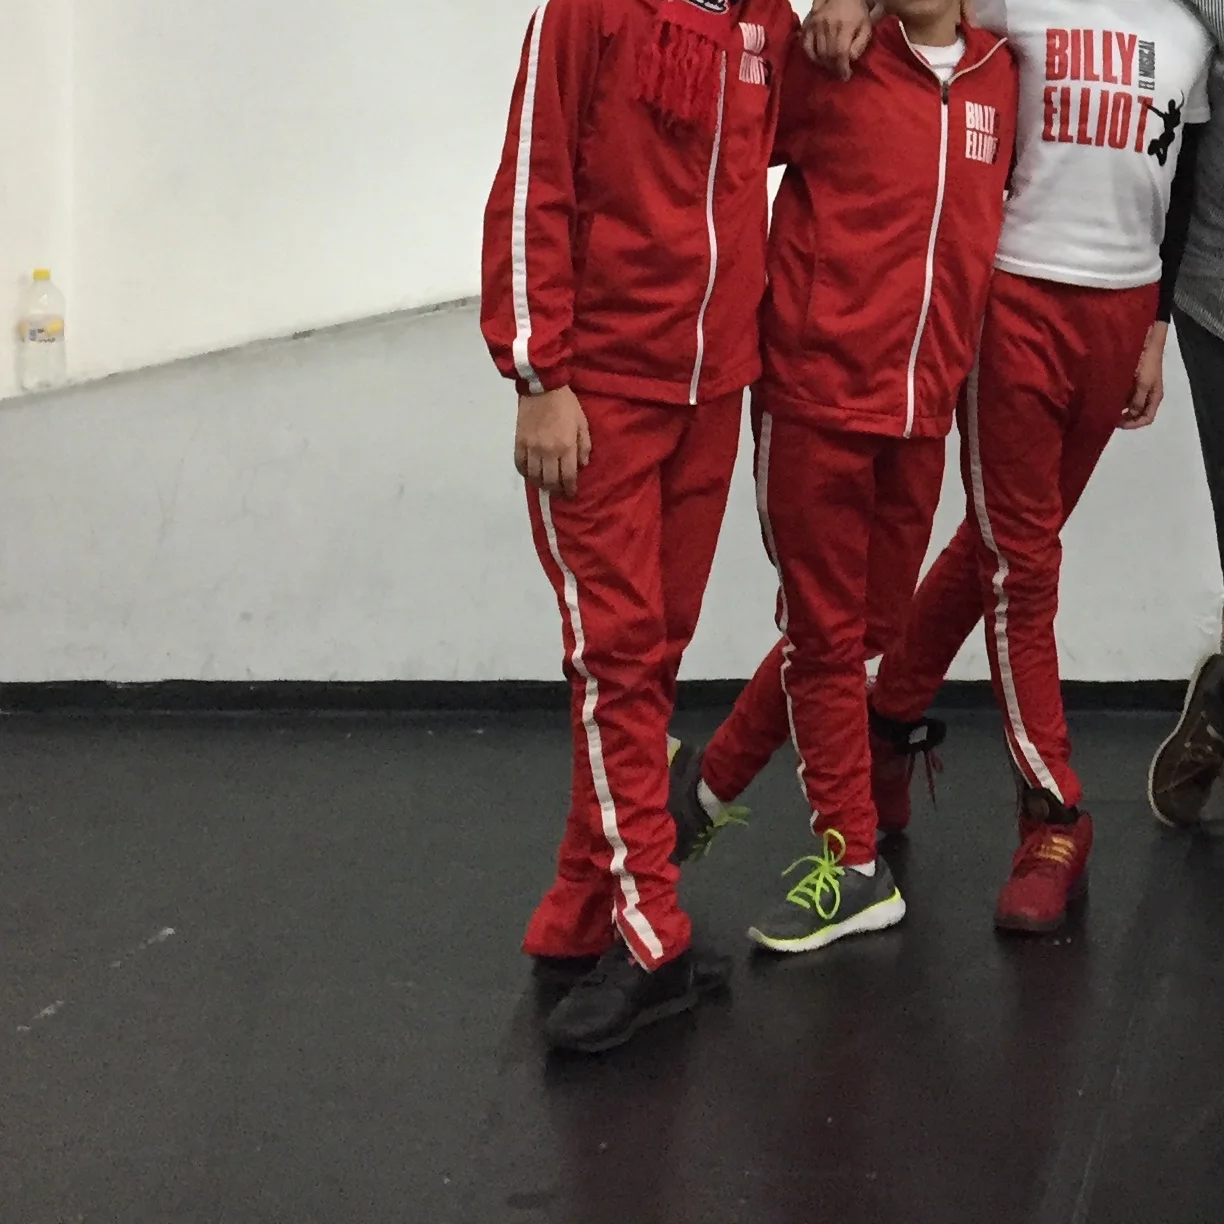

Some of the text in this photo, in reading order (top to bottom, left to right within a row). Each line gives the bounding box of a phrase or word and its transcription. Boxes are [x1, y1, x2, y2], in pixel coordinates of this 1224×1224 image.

[1045, 28, 1138, 86] BILLY
[965, 100, 996, 134] BILLY
[1042, 86, 1154, 153] ELLIOT
